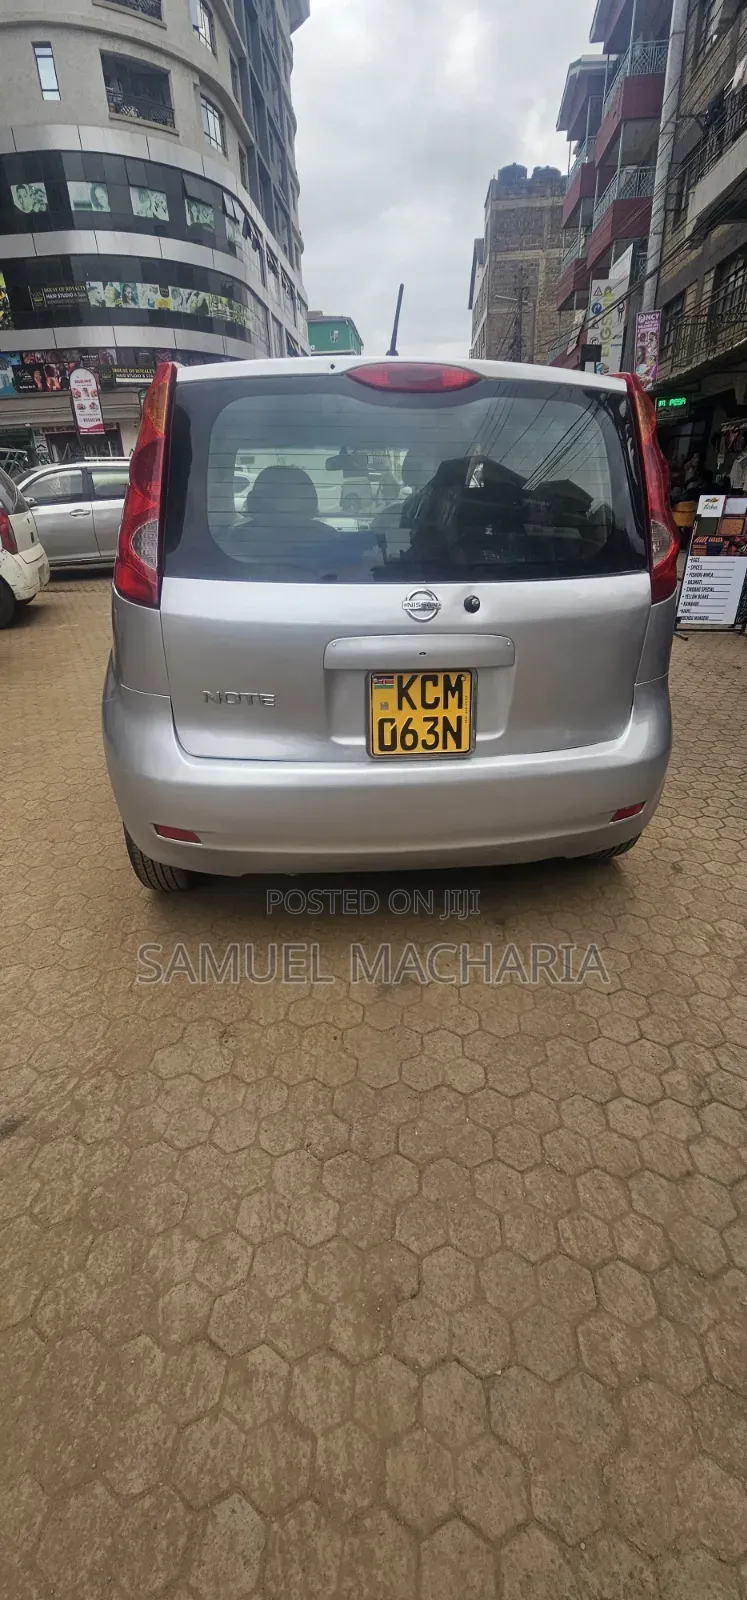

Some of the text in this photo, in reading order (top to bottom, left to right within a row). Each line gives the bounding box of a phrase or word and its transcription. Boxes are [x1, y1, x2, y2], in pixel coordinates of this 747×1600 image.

[406, 601, 440, 609] NISSAN
[202, 690, 276, 707] NOTE
[397, 674, 463, 711] KCM
[378, 716, 462, 751] 063N
